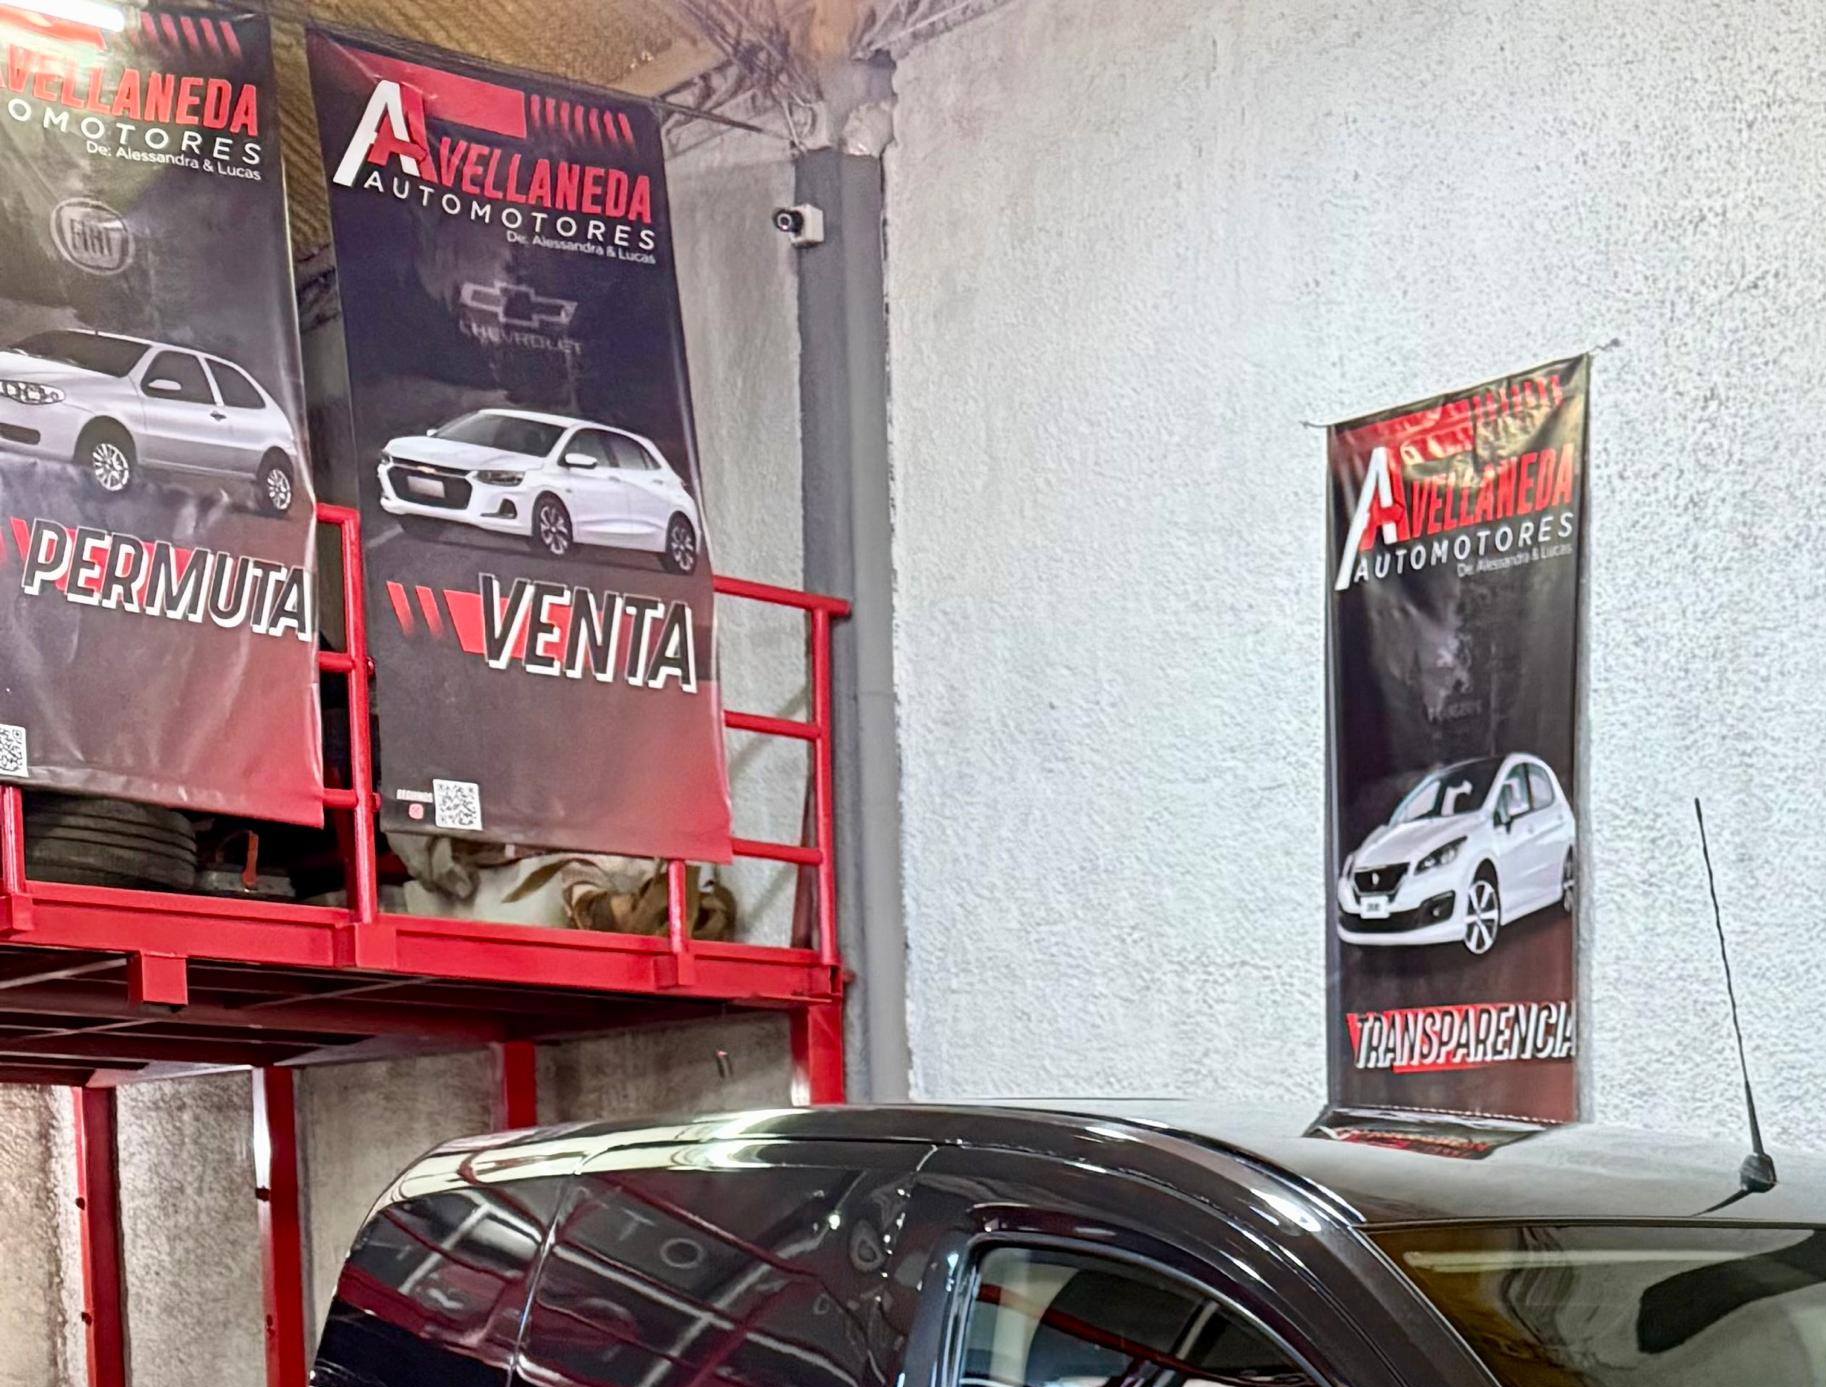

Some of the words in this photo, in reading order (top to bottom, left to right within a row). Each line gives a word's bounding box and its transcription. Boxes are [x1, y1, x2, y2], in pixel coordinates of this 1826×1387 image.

[0, 43, 259, 136] VELLANEDA
[8, 98, 262, 165] OMOTORES
[86, 141, 111, 157] De:
[116, 146, 199, 169] Alessandra
[202, 160, 214, 172] &
[217, 161, 261, 180] Lucas
[333, 80, 652, 223] AVELLANEDA
[364, 170, 656, 250] AUTOMOTORES
[532, 235, 604, 255] Alessandra
[618, 247, 656, 264] Lucas
[1334, 443, 1576, 591] AVELLANEDA
[1354, 511, 1575, 583] AUTOMOTORES
[21, 518, 312, 642] PERMUTA
[478, 572, 698, 694] VENTA
